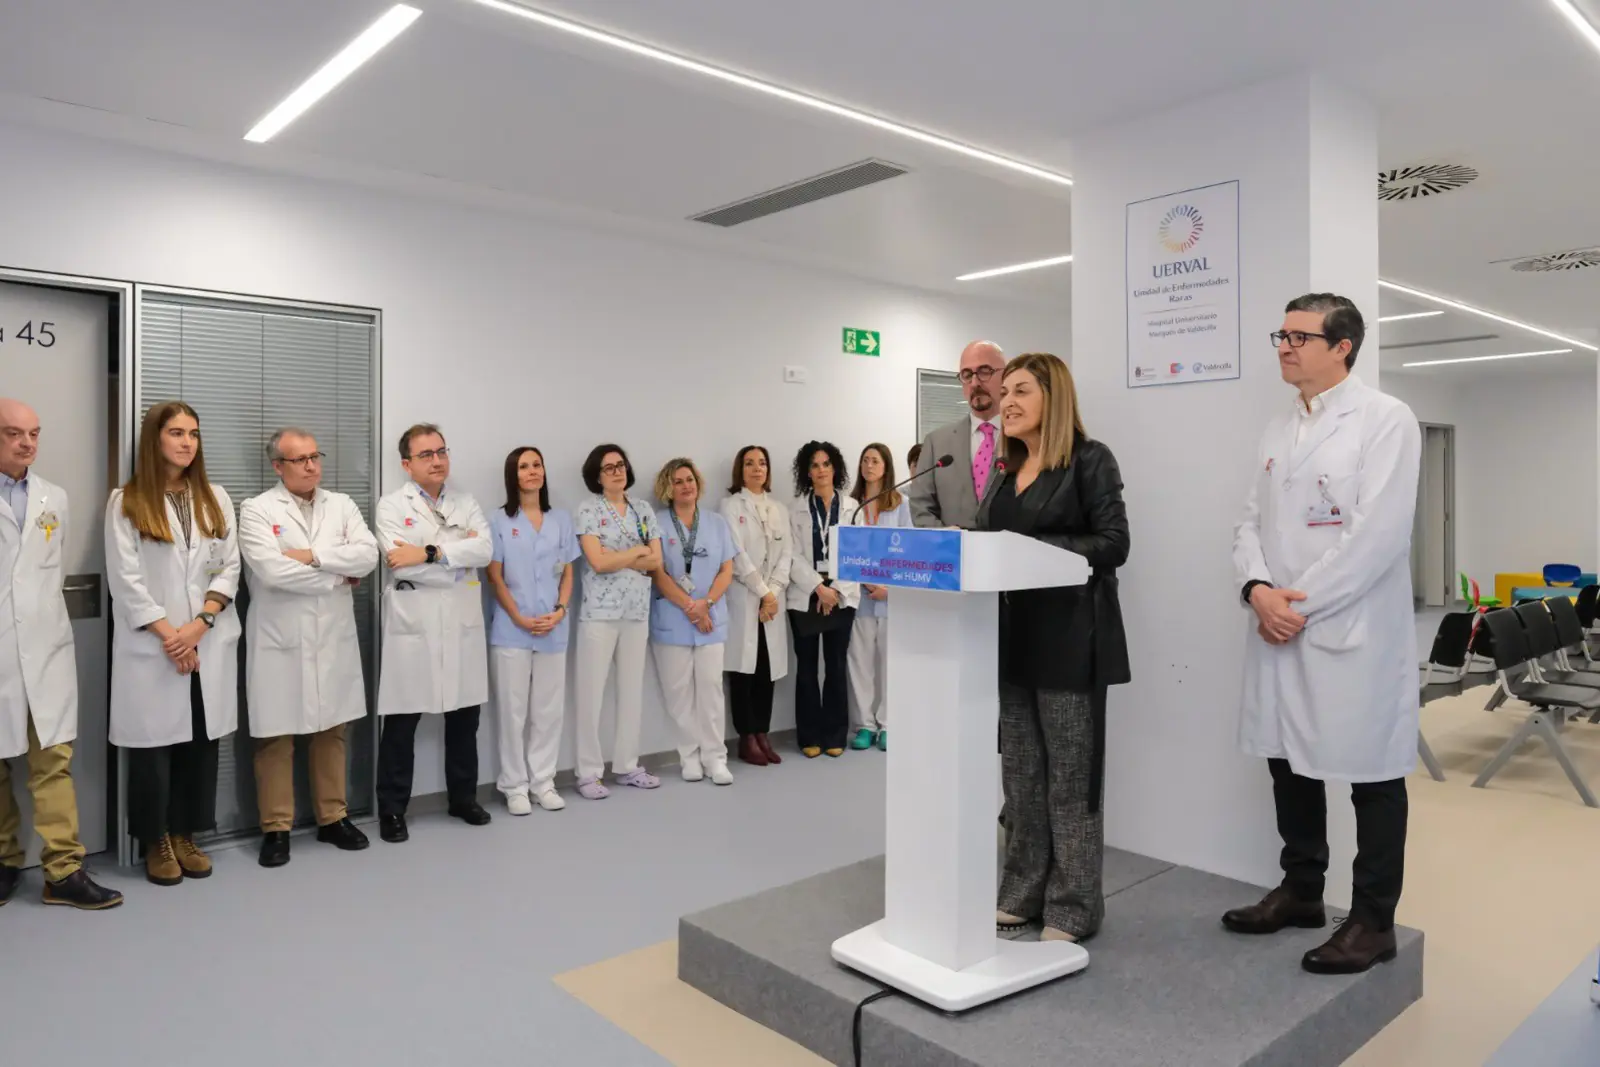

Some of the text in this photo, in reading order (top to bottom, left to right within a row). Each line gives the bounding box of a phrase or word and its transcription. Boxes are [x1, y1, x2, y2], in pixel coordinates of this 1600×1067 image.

[1152, 256, 1211, 279] UERVAL
[1133, 276, 1230, 298] Unidad de Enfermedades
[1169, 293, 1192, 303] Raras
[1147, 312, 1218, 327] Hospital Universitario
[16, 320, 56, 347] 45
[1177, 325, 1186, 334] de
[1187, 323, 1217, 333] Valdecilla
[842, 555, 871, 566] Unidad
[880, 558, 954, 573] ENFERMEDADES
[860, 568, 932, 583] RARAS del HUMV
